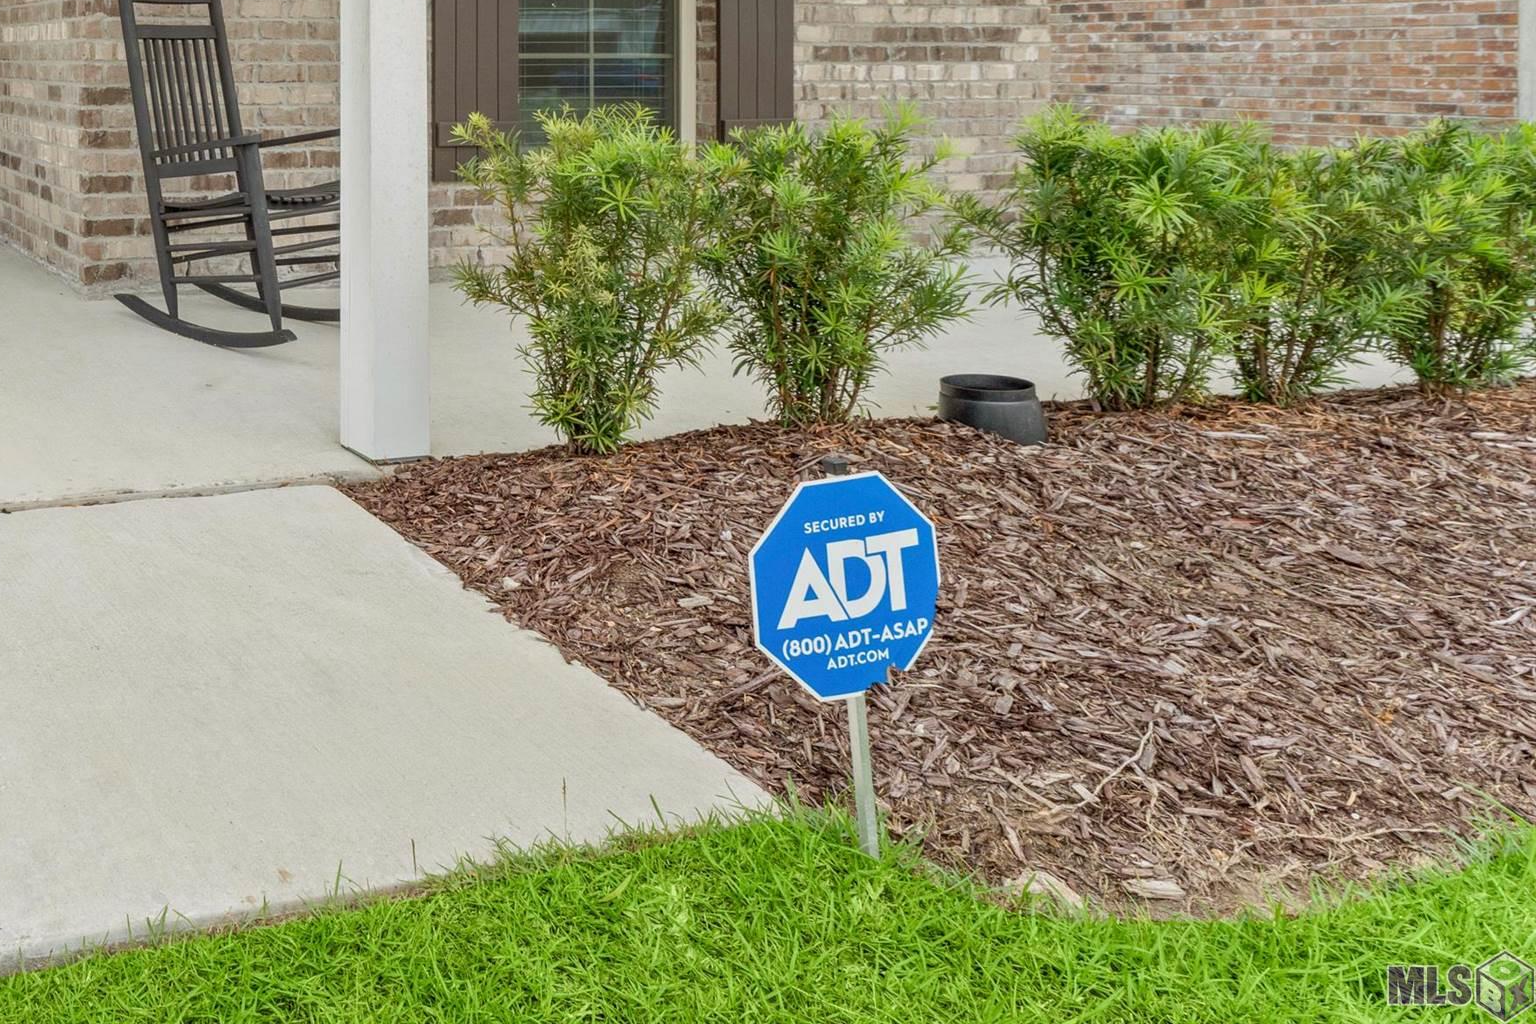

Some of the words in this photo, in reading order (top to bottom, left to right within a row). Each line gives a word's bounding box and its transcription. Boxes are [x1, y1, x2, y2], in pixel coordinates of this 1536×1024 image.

[804, 513, 865, 534] SECURED
[869, 510, 885, 524] BY
[776, 528, 919, 630] ADT
[782, 634, 832, 661] (800)
[835, 617, 929, 651] ADT-ASAP
[826, 648, 889, 670] ADT.COM
